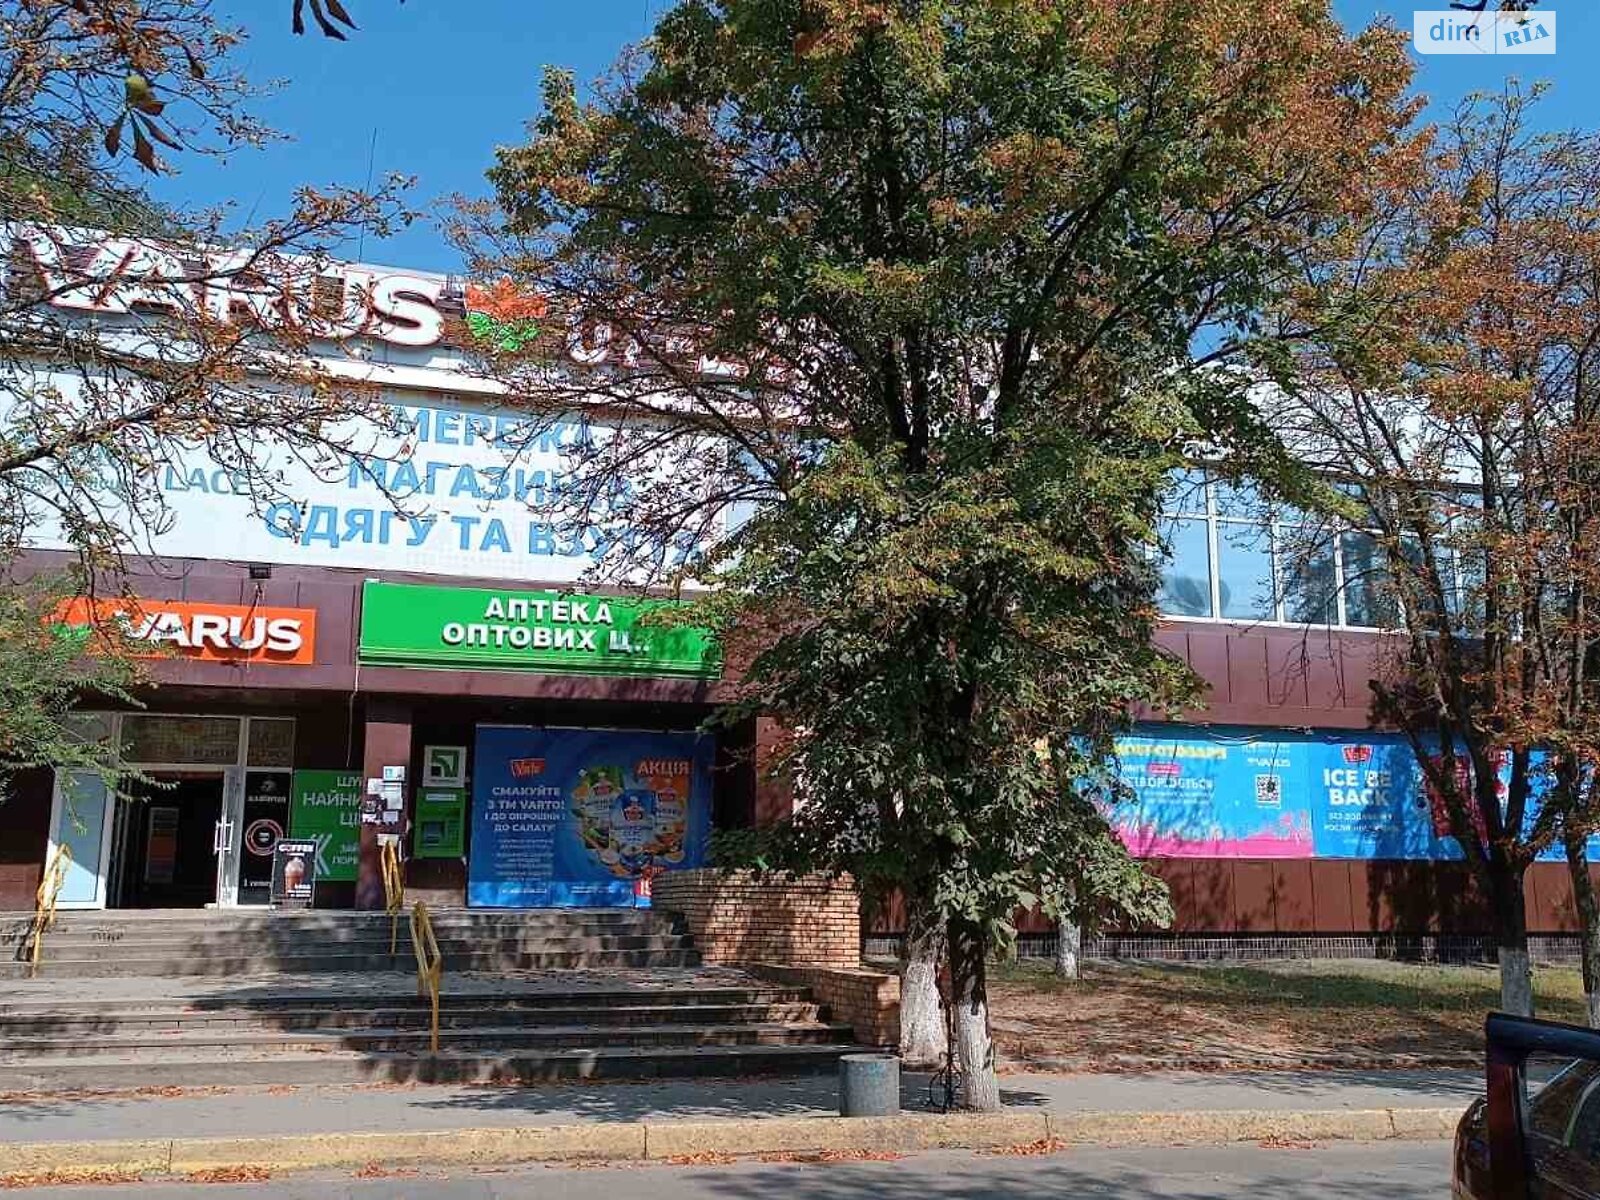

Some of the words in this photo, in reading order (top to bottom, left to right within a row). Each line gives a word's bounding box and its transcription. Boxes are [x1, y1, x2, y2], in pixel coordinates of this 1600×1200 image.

[17, 225, 446, 347] VARUS
[265, 501, 438, 549] ОДЯГУ
[451, 515, 512, 553] ТА
[484, 597, 615, 625] АПТЕКА
[112, 609, 304, 651] VARUS
[442, 623, 597, 650] ОПТОВИХ
[636, 760, 690, 778] АКЦІЯ
[1323, 768, 1358, 787] ICE
[1366, 769, 1393, 788] BE
[492, 785, 561, 796] СМАКУЙТЕ
[1329, 789, 1391, 806] BACK
